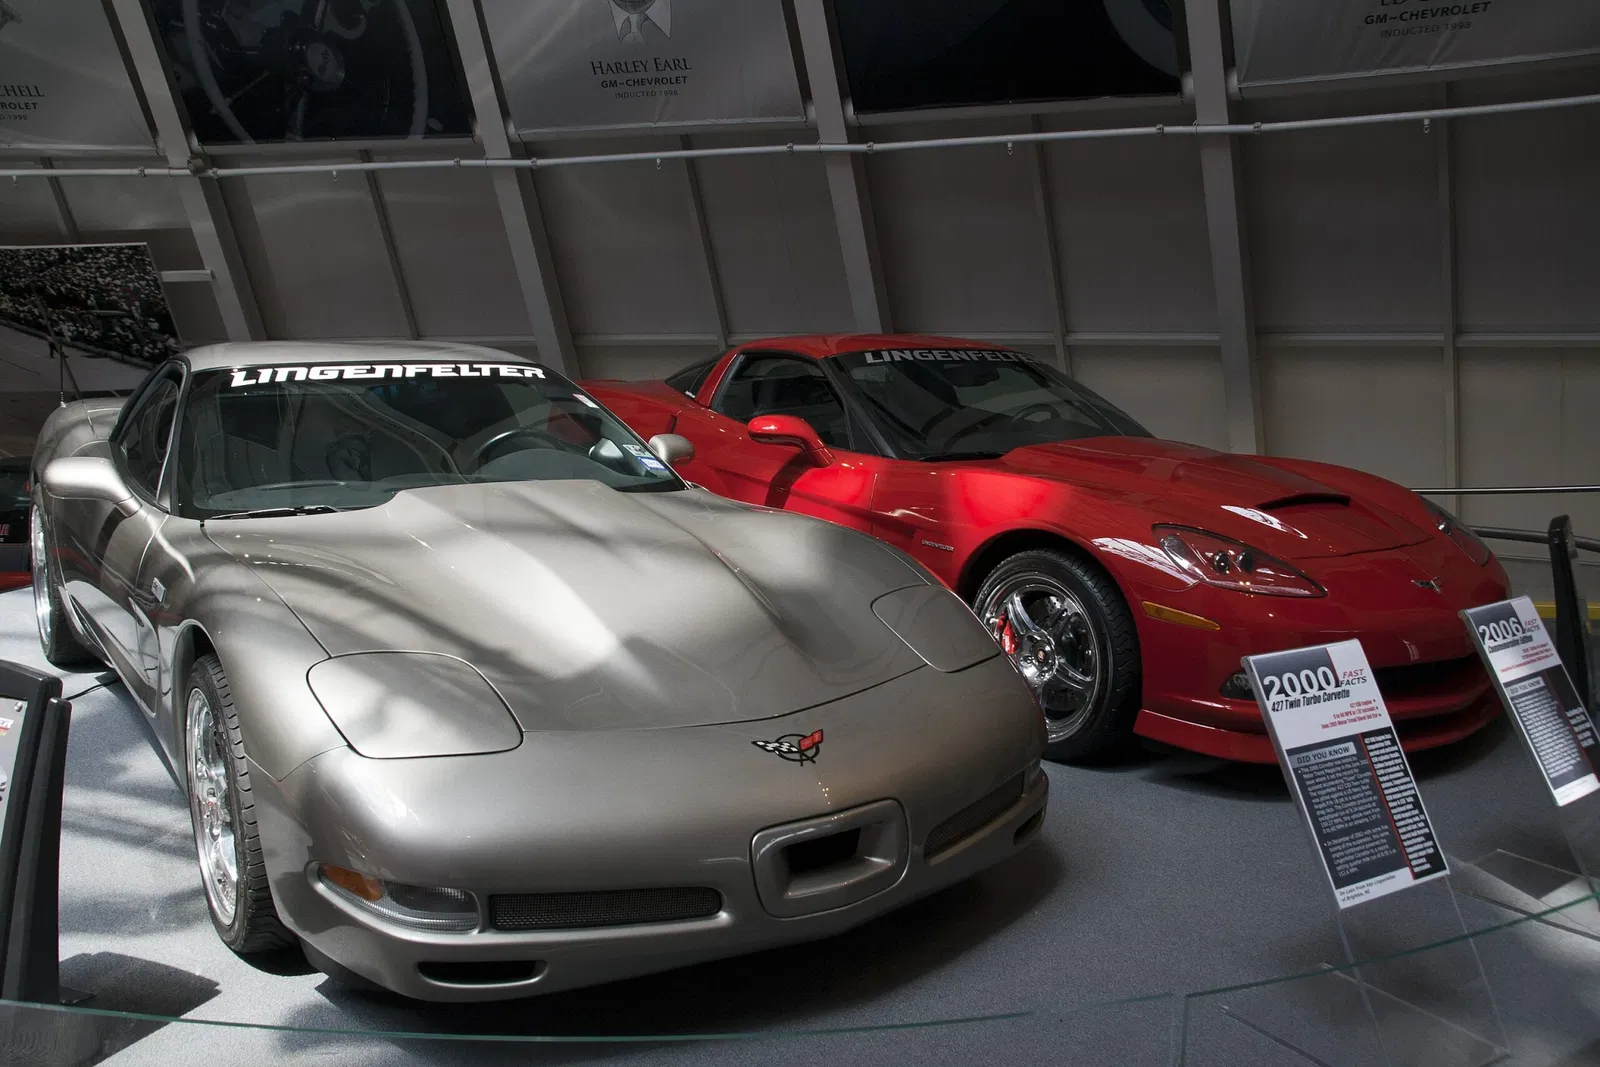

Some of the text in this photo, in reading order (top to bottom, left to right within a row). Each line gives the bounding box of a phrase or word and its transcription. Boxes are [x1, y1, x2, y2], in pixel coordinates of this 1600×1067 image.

[1380, 21, 1472, 38] INDUCTED 1998
[590, 57, 692, 76] HARLEY EARL
[614, 89, 679, 100] INDUCTED 1998
[864, 350, 1035, 364] LINGENFELTE
[230, 363, 546, 388] LINGENFELTER
[1478, 617, 1522, 646] 2006
[1340, 676, 1367, 687] FACTS
[1342, 668, 1364, 678] FAST
[1264, 666, 1336, 700] 2000
[1271, 689, 1350, 712] 427 Twin Turbo Corvette
[1296, 746, 1350, 764] DID YOU KNOW
